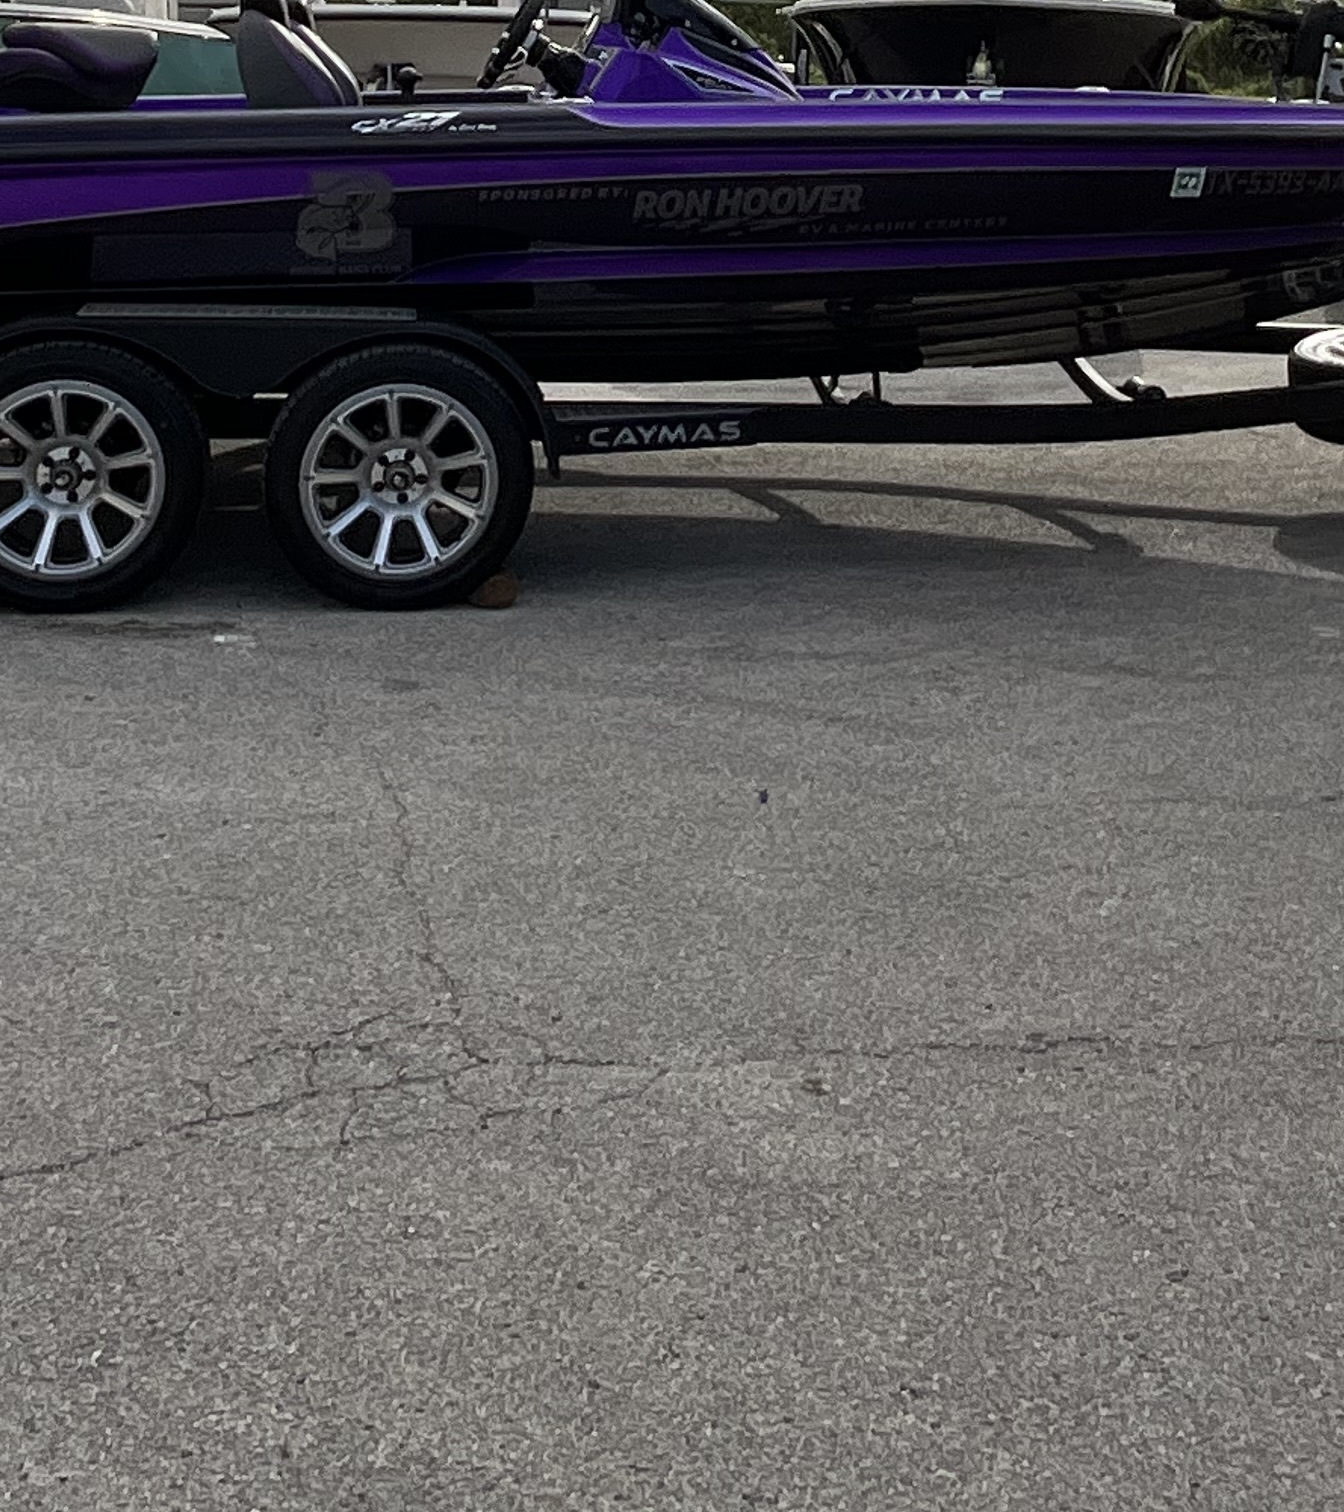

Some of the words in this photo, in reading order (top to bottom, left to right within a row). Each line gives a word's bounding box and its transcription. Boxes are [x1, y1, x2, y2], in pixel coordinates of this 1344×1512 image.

[633, 189, 712, 219] RON
[714, 184, 864, 217] HOOVER
[587, 420, 743, 450] CAYMAS
